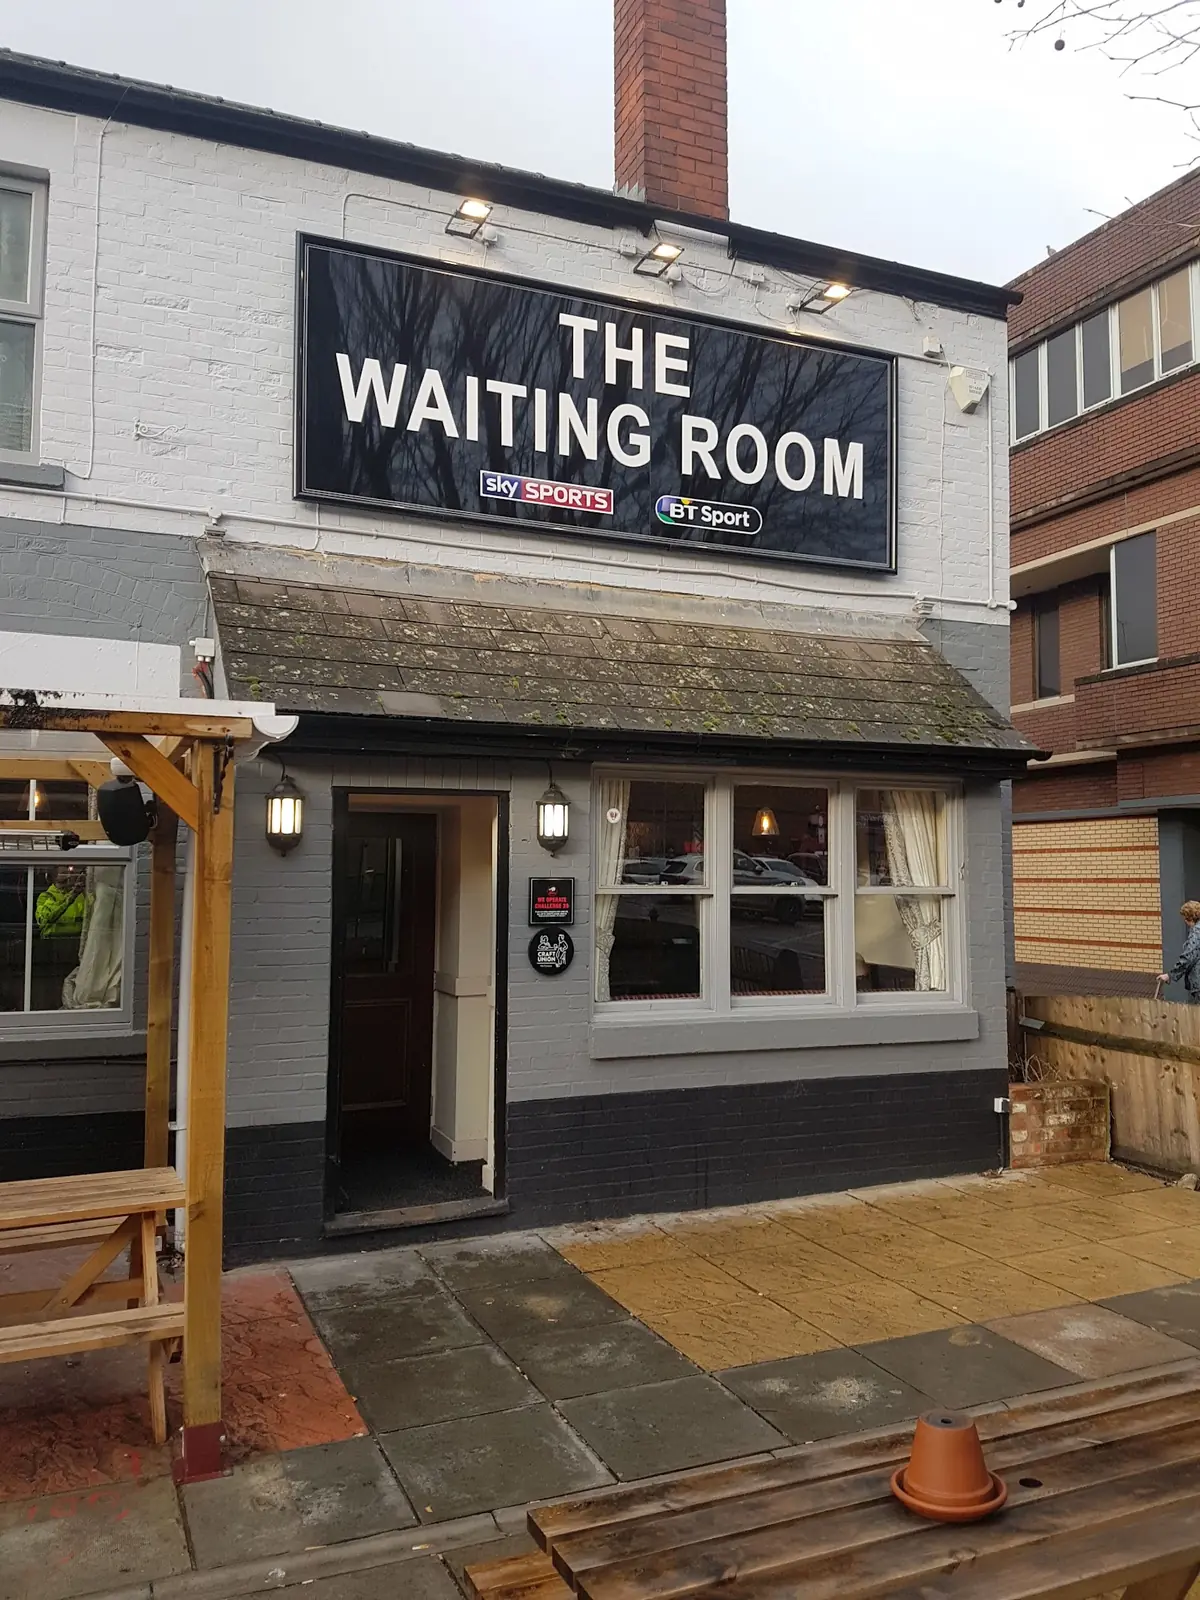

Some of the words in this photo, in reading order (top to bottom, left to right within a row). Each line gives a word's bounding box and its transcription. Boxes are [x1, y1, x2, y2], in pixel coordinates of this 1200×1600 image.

[558, 312, 691, 398] THE
[335, 352, 651, 468] WAITING
[681, 414, 864, 500] ROOM
[486, 475, 519, 498] sky
[525, 482, 608, 510] SPORTS
[669, 502, 699, 521] BT
[701, 506, 750, 527] Sport
